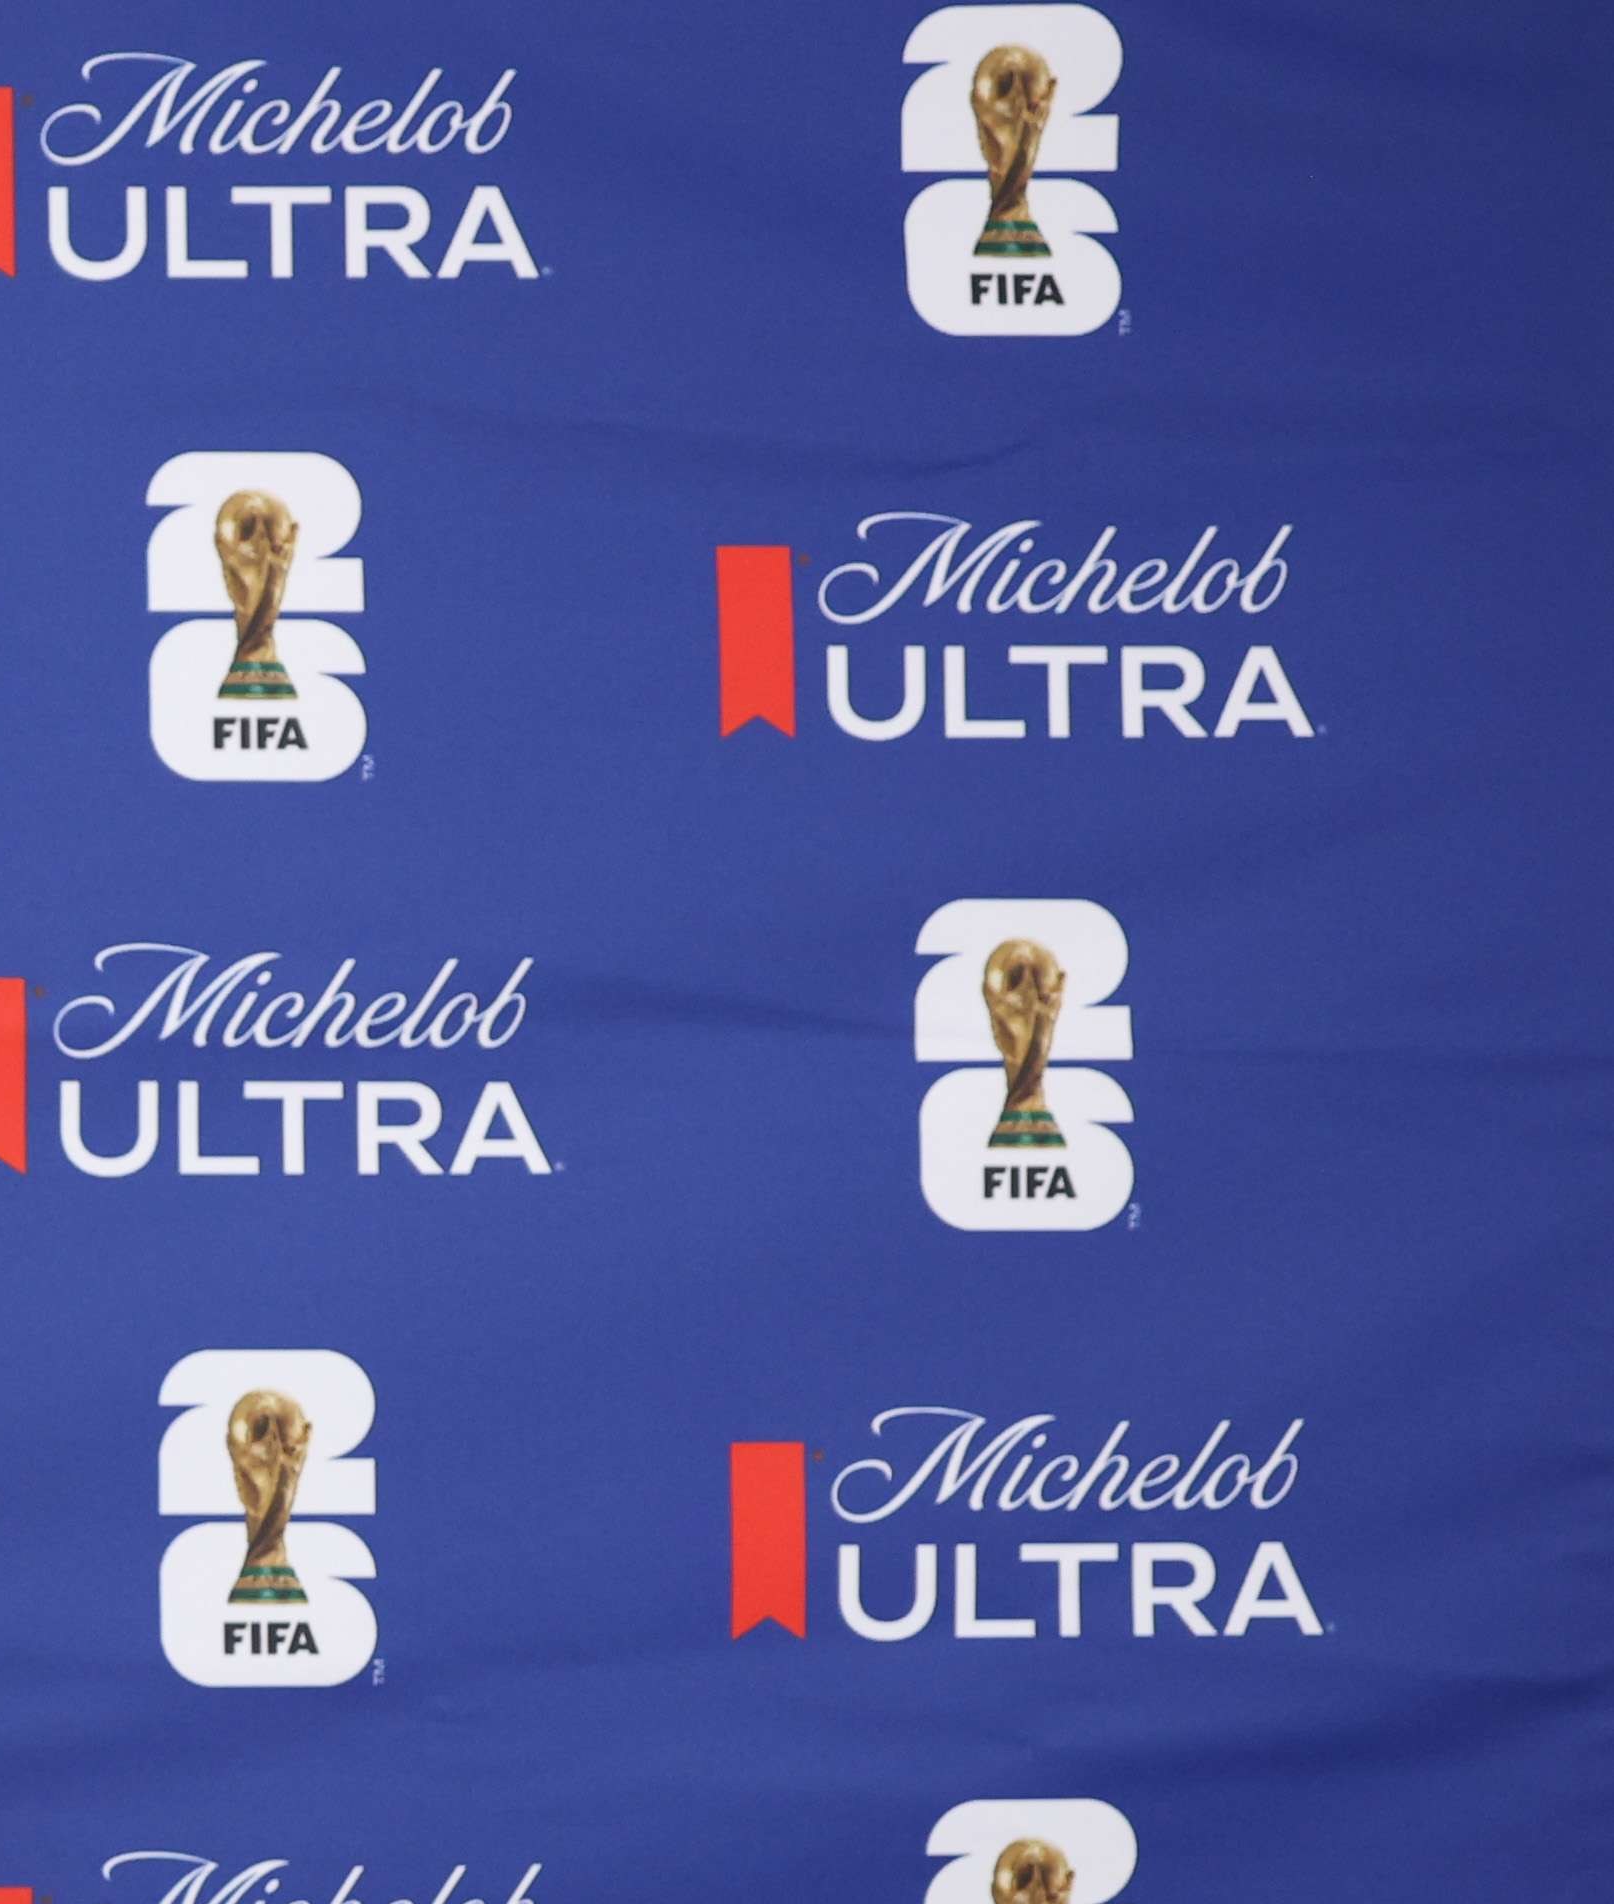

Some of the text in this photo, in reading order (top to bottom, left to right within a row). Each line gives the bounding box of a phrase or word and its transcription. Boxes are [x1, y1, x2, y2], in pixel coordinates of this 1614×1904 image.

[40, 53, 516, 166] Michelob
[48, 186, 539, 281] ULTRA
[970, 273, 1064, 305] FIFA
[818, 512, 1292, 624] Michelob
[213, 717, 307, 750] FIFA
[826, 645, 1314, 741] ULTRA
[54, 943, 533, 1059] Michelob
[60, 1080, 552, 1177] ULTRA
[984, 1166, 1076, 1199] FIFA
[831, 1407, 1303, 1523] Michelob
[224, 1622, 319, 1655] FIFA
[838, 1542, 1323, 1641] ULTRA
